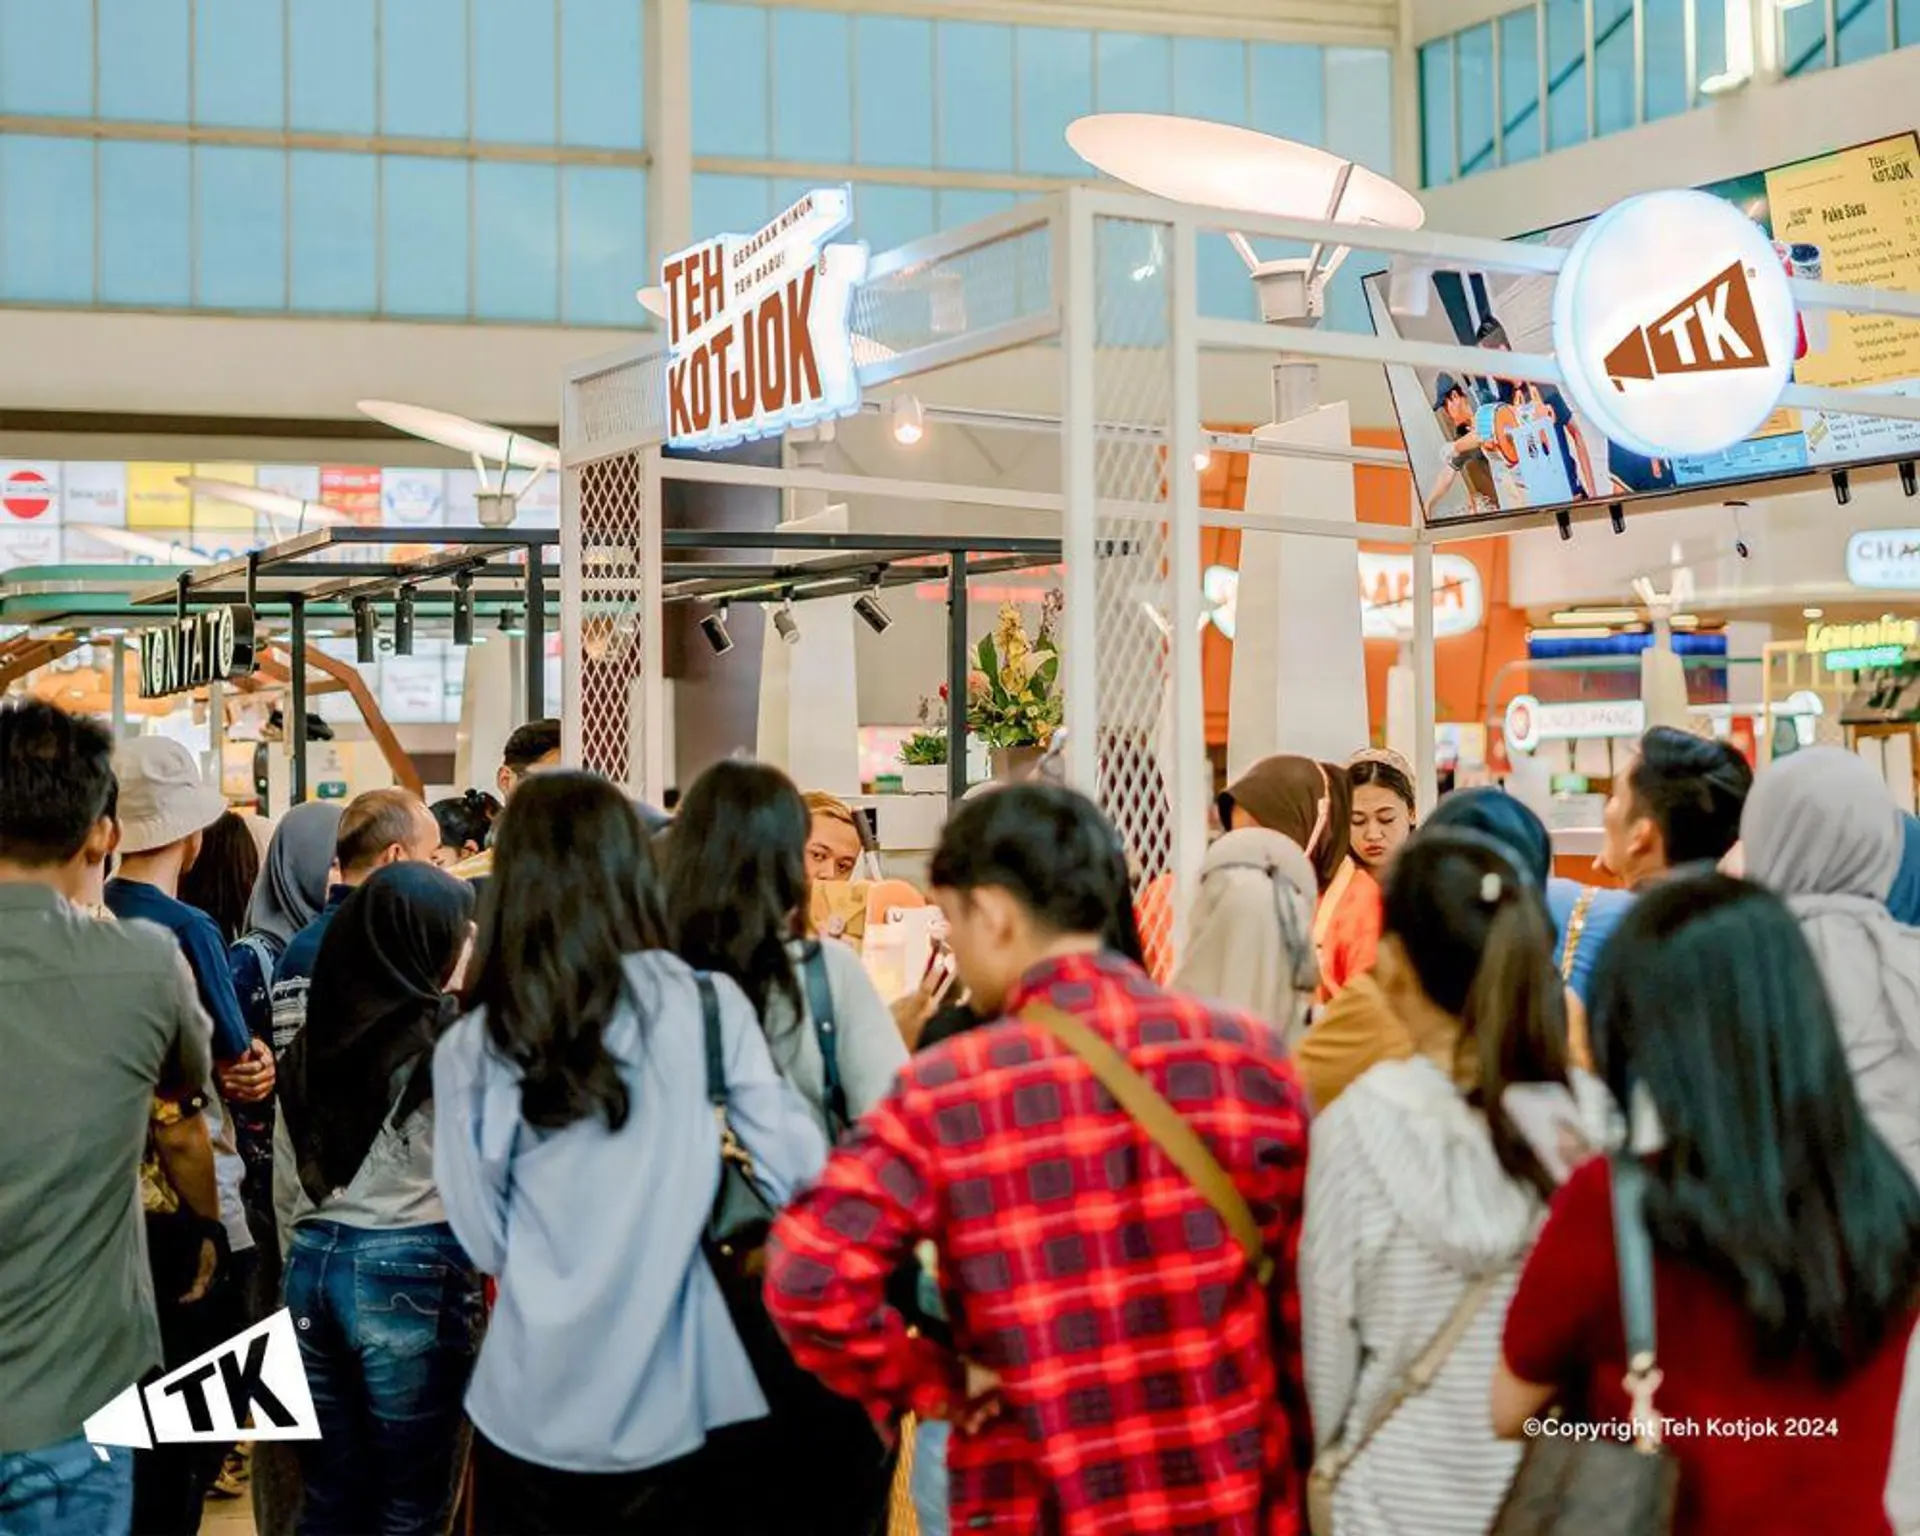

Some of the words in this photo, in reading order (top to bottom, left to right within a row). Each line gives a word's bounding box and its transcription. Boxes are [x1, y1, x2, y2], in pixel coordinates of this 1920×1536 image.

[733, 223, 777, 268] GERAKAN
[780, 196, 813, 231] MINUM
[664, 243, 724, 345] TEH
[734, 273, 752, 296] TEH
[1658, 280, 1754, 365] TK
[668, 264, 823, 437] KOTJOK
